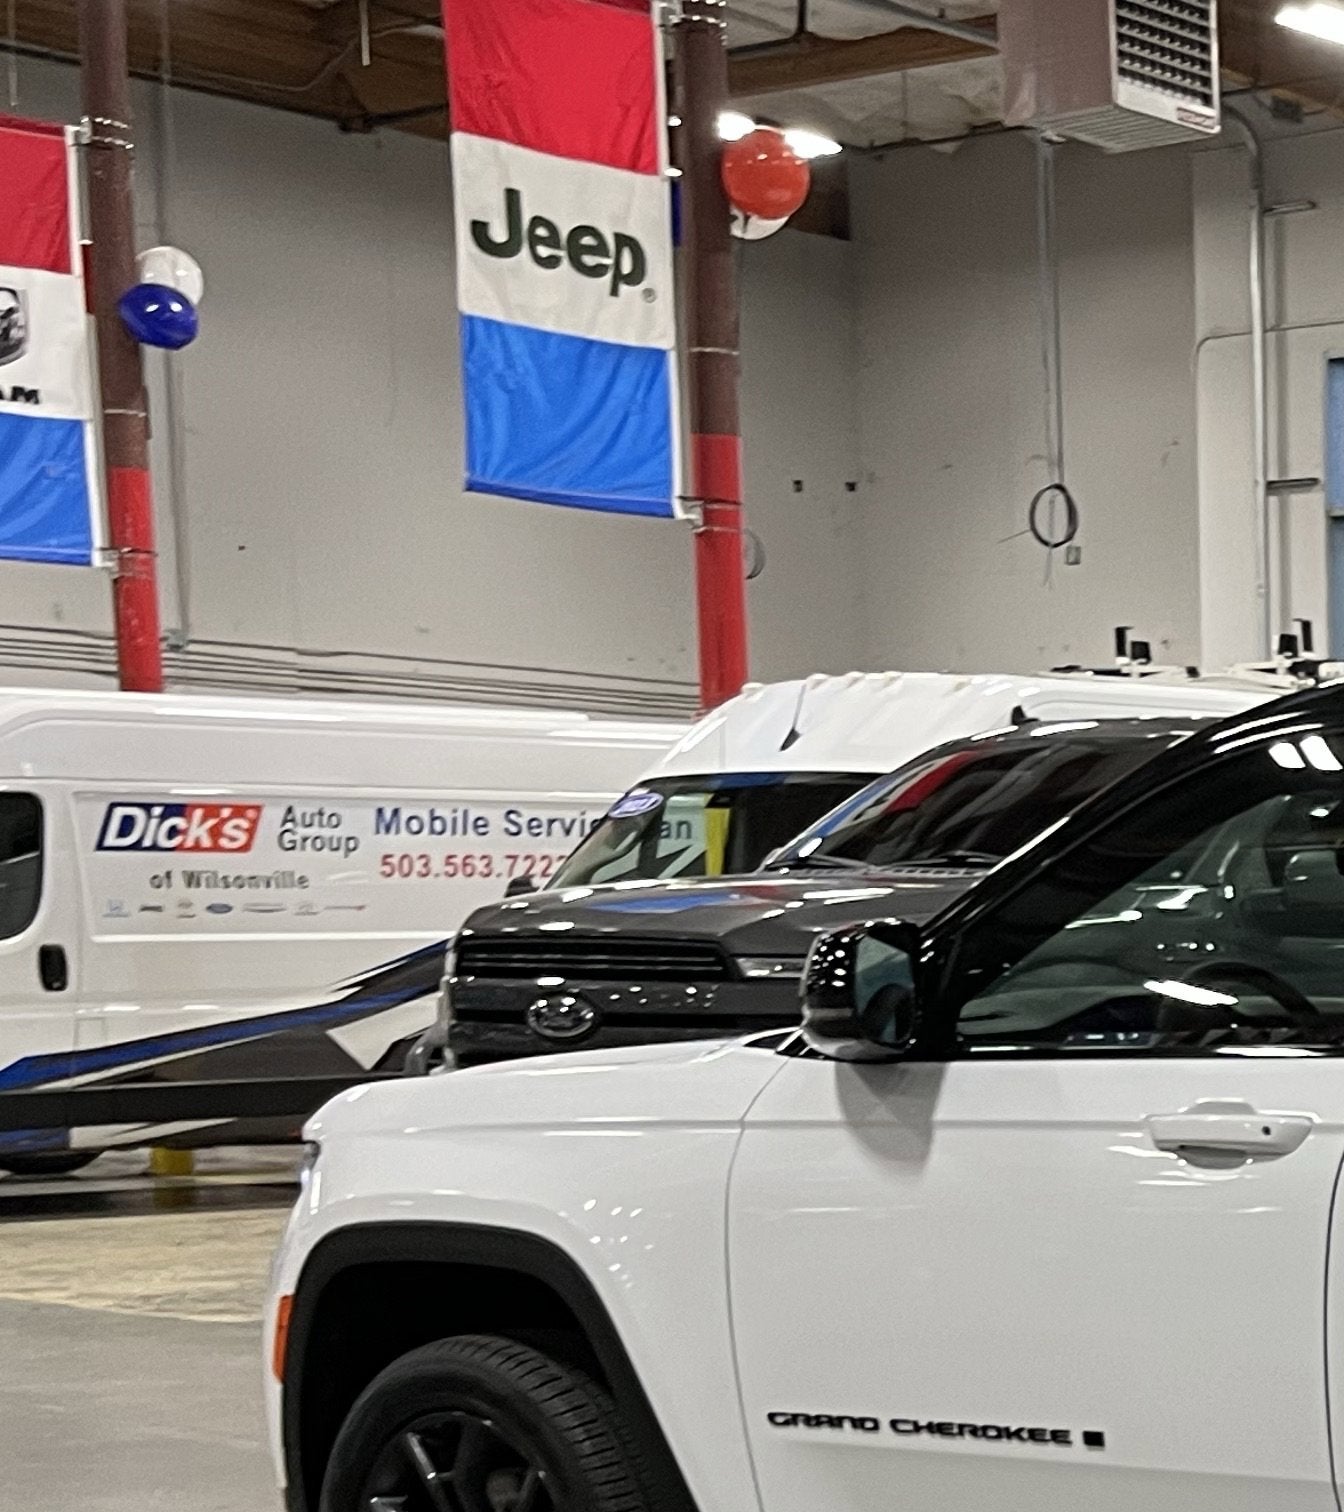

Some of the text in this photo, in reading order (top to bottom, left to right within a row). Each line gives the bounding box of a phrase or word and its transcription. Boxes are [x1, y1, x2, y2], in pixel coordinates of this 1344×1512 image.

[470, 187, 646, 297] Jeep
[102, 806, 251, 849] Dick's
[281, 805, 342, 829] Auto
[374, 806, 490, 836] Mobile
[503, 809, 605, 837] Servi
[277, 829, 360, 857] Group
[150, 870, 309, 889] of Wilsonville
[767, 1412, 880, 1431] GRAND
[889, 1418, 1073, 1446] CHEROKEE
